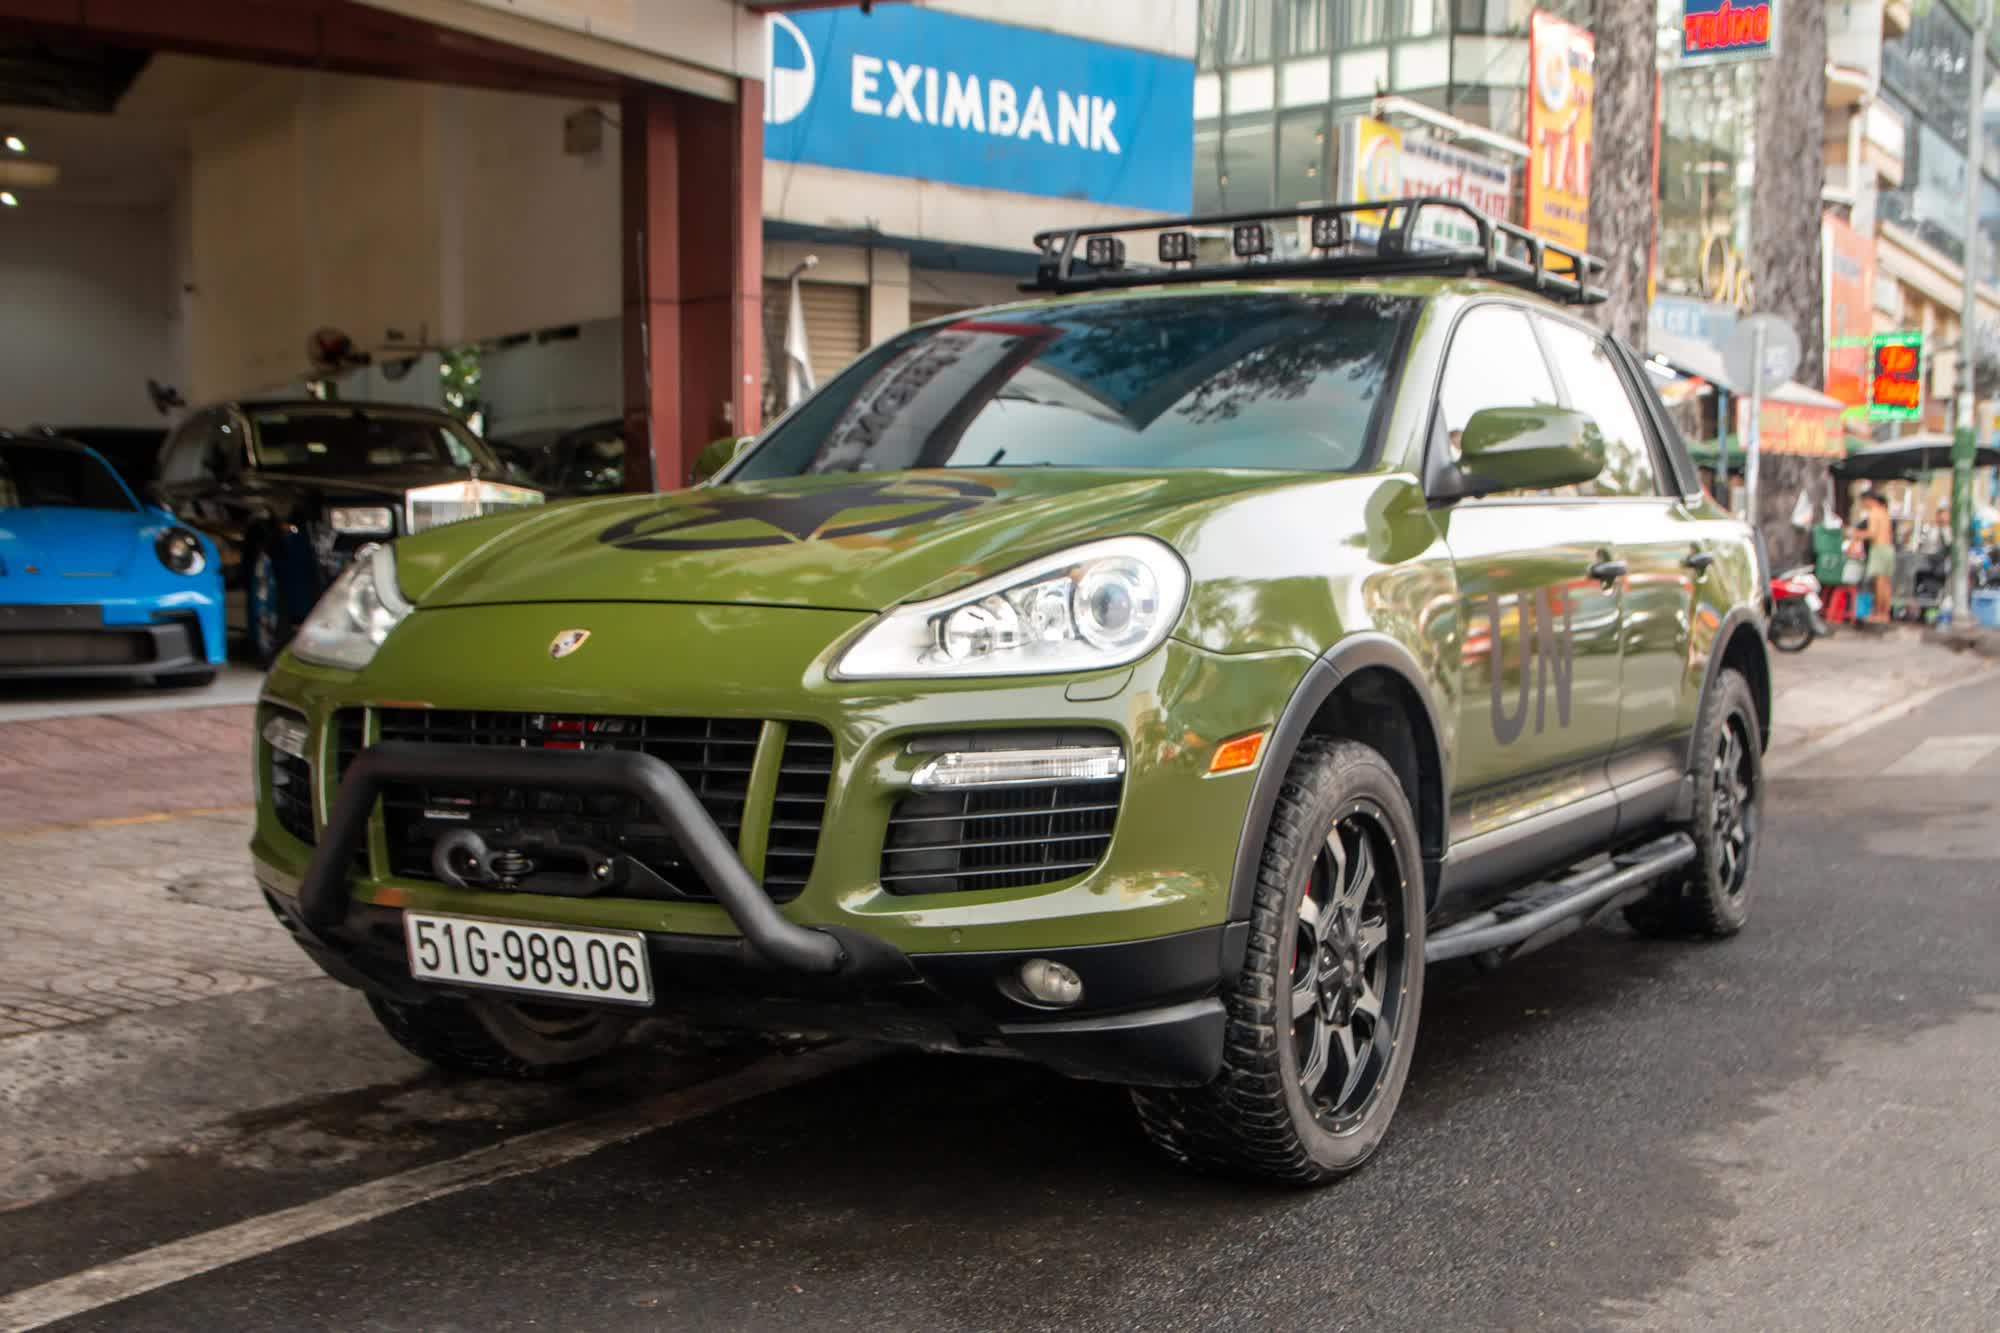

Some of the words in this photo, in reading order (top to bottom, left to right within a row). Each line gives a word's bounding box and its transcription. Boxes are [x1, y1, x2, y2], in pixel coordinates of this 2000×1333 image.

[850, 53, 1121, 155] EXIMBANK
[1488, 585, 1572, 746] UN
[415, 919, 641, 994] 51G-989.06
